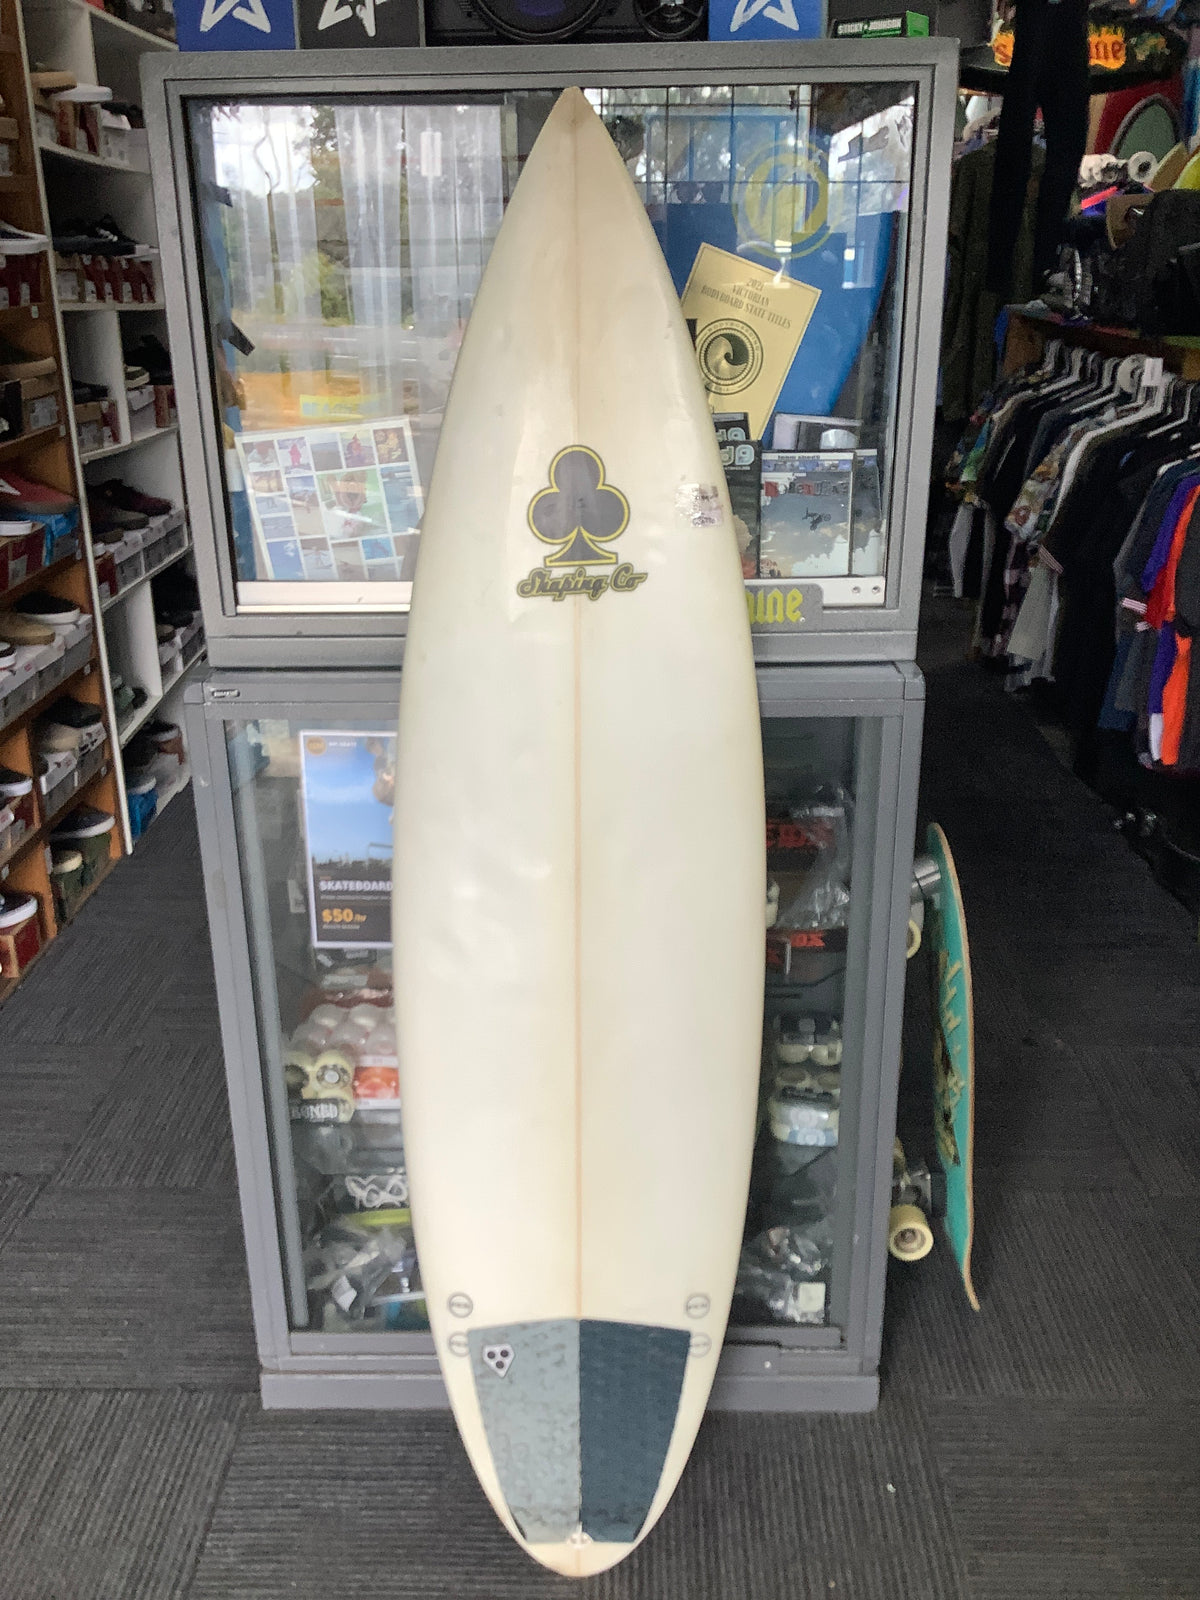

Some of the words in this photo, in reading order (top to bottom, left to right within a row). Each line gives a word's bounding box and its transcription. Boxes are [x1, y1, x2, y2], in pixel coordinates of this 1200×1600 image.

[701, 284, 745, 310] BODYBOARD
[744, 303, 766, 319] STATE
[767, 312, 792, 329] TITLES
[732, 284, 770, 307] VICTORIAN
[516, 566, 610, 601] Shaping
[610, 562, 648, 592] Co
